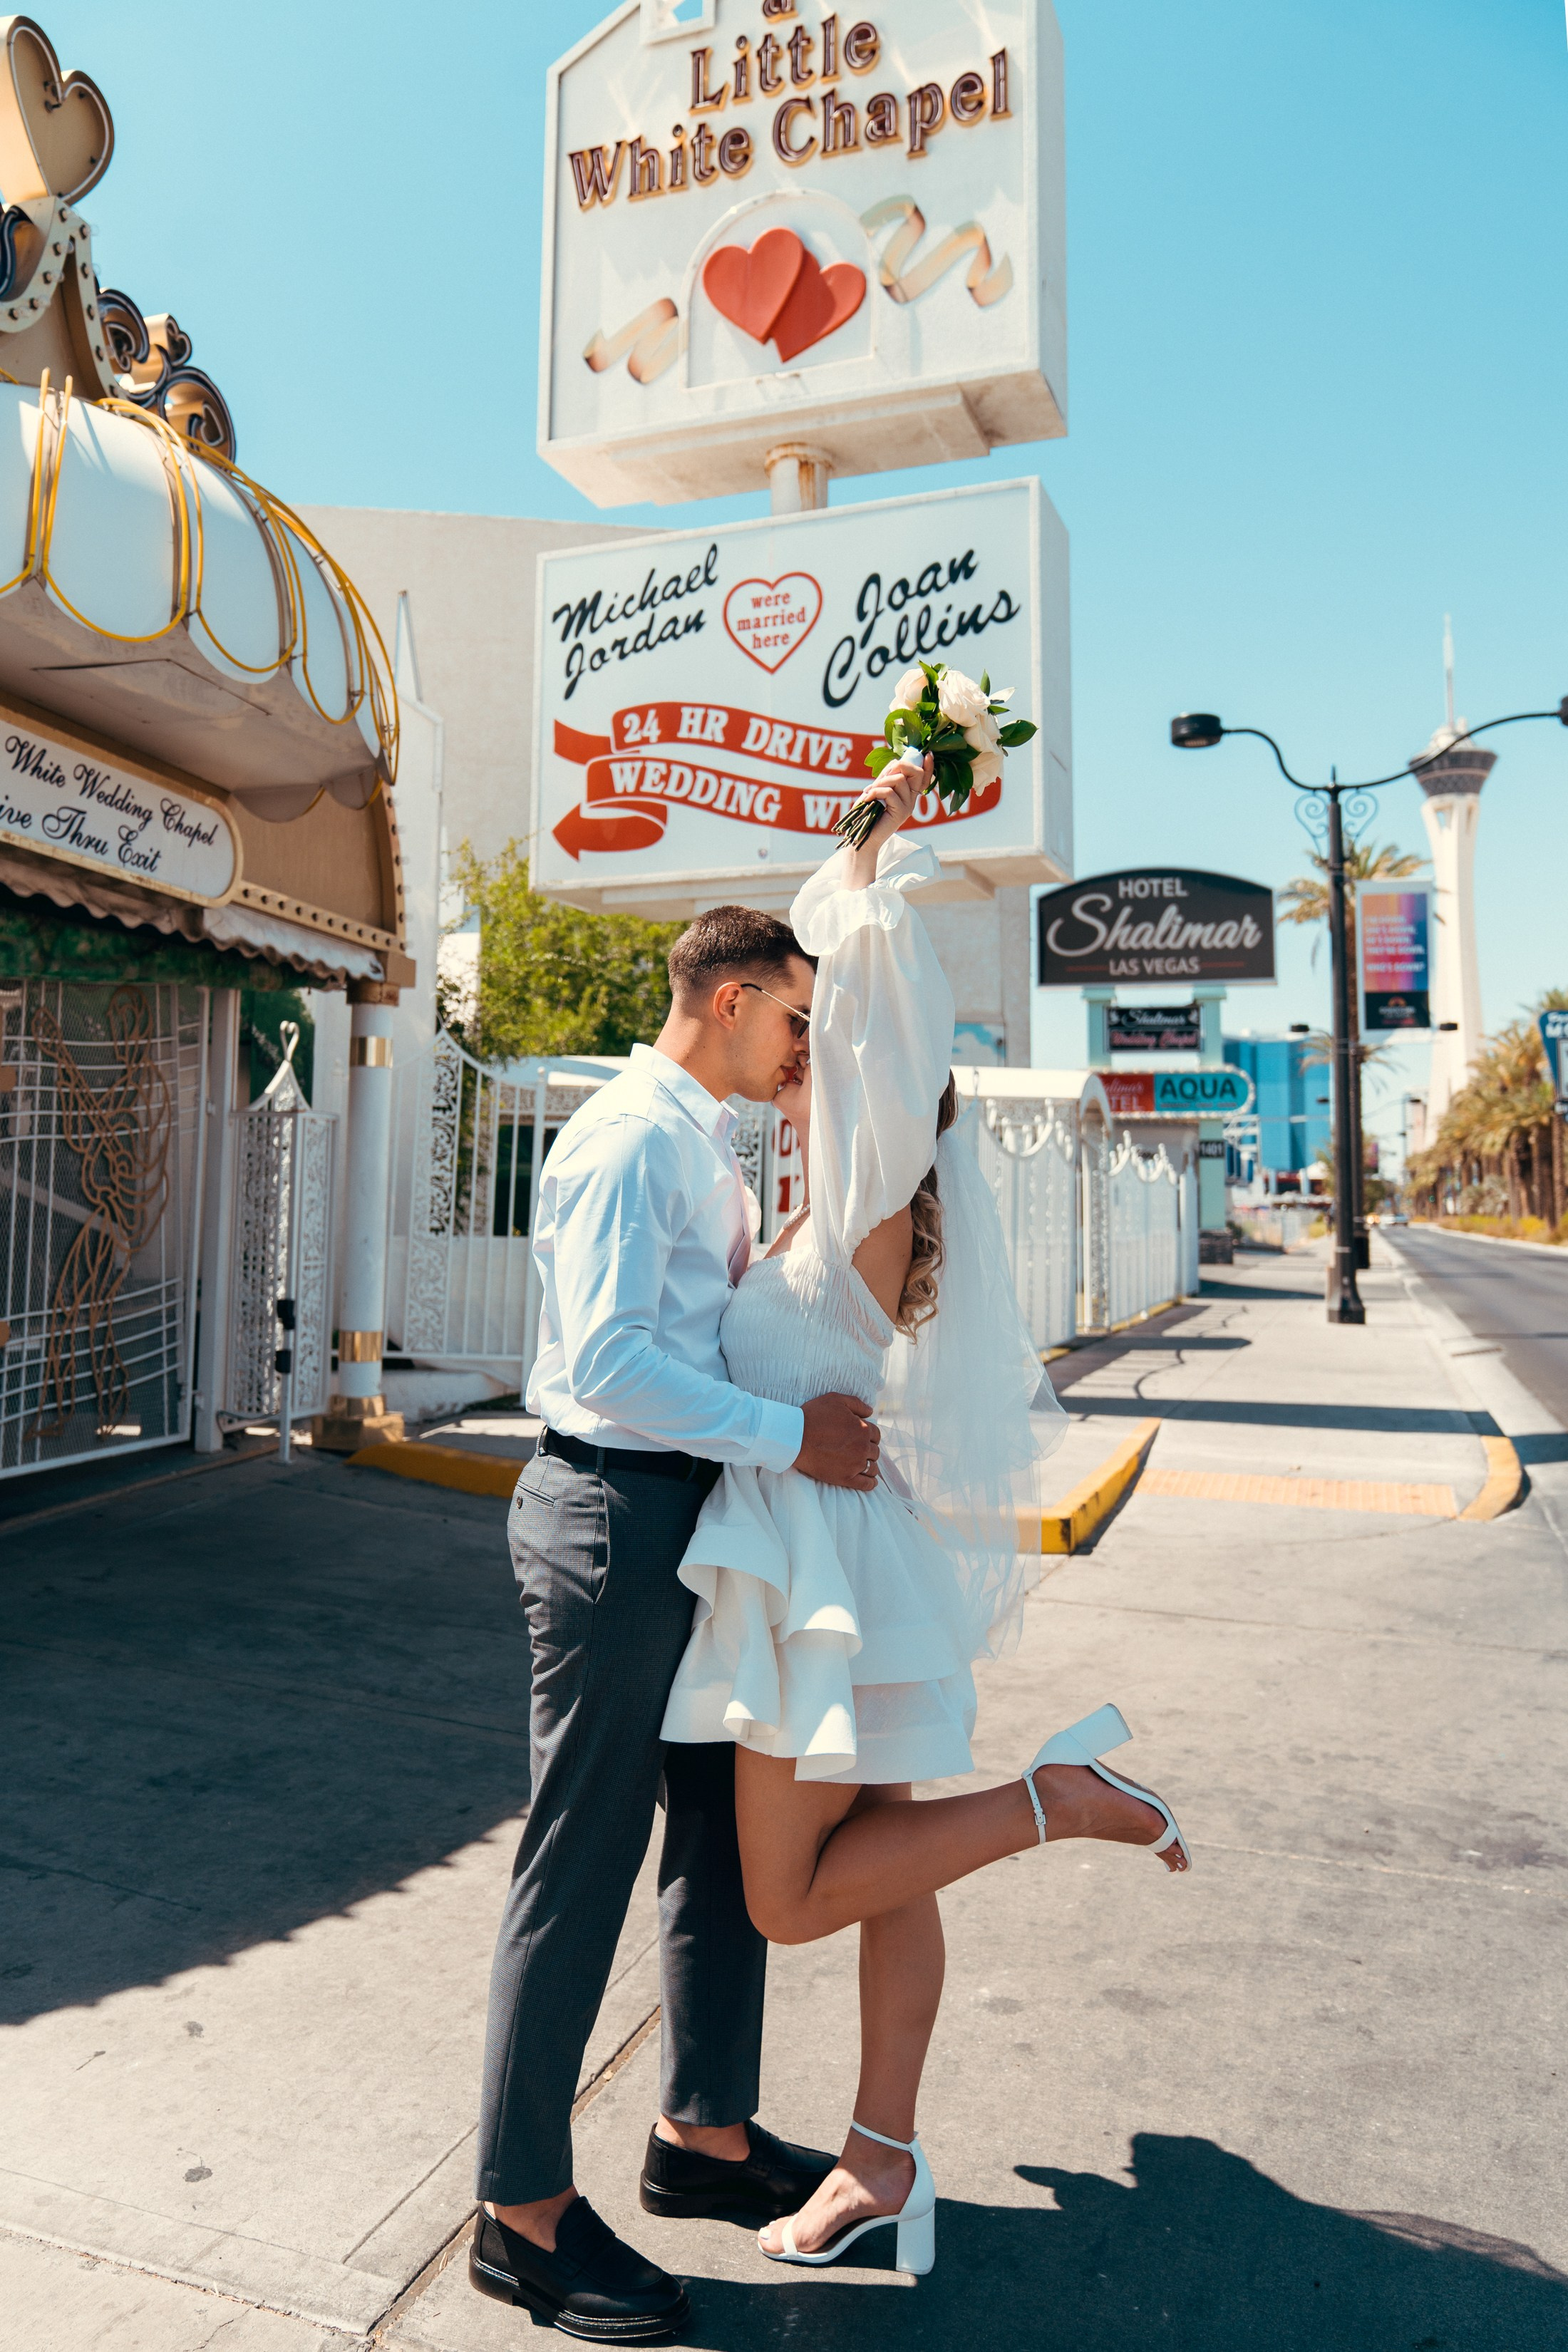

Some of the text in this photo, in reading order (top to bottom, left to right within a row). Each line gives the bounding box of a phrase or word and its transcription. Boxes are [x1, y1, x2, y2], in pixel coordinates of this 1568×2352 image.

[689, 14, 881, 115] Little
[568, 48, 1012, 212] White Chapel
[552, 542, 718, 643] Michael
[737, 606, 806, 631] married
[751, 592, 790, 609] were
[855, 548, 979, 641] Joan
[563, 608, 707, 701] Jordan
[753, 633, 790, 649] here
[821, 589, 1022, 708] Collins
[622, 707, 852, 772] 24 HR DRIVE
[5, 735, 219, 847] White Wedding Chapel
[609, 760, 970, 830] WEDDING WIOW
[41, 806, 109, 856] Thru
[118, 825, 163, 872] Exit
[1118, 877, 1189, 899] HOTEL
[1046, 892, 1263, 957] Shalimar
[1108, 956, 1201, 976] LAS VEGAS
[1110, 1094, 1145, 1112] TEL
[1160, 1077, 1237, 1100] AQUA
